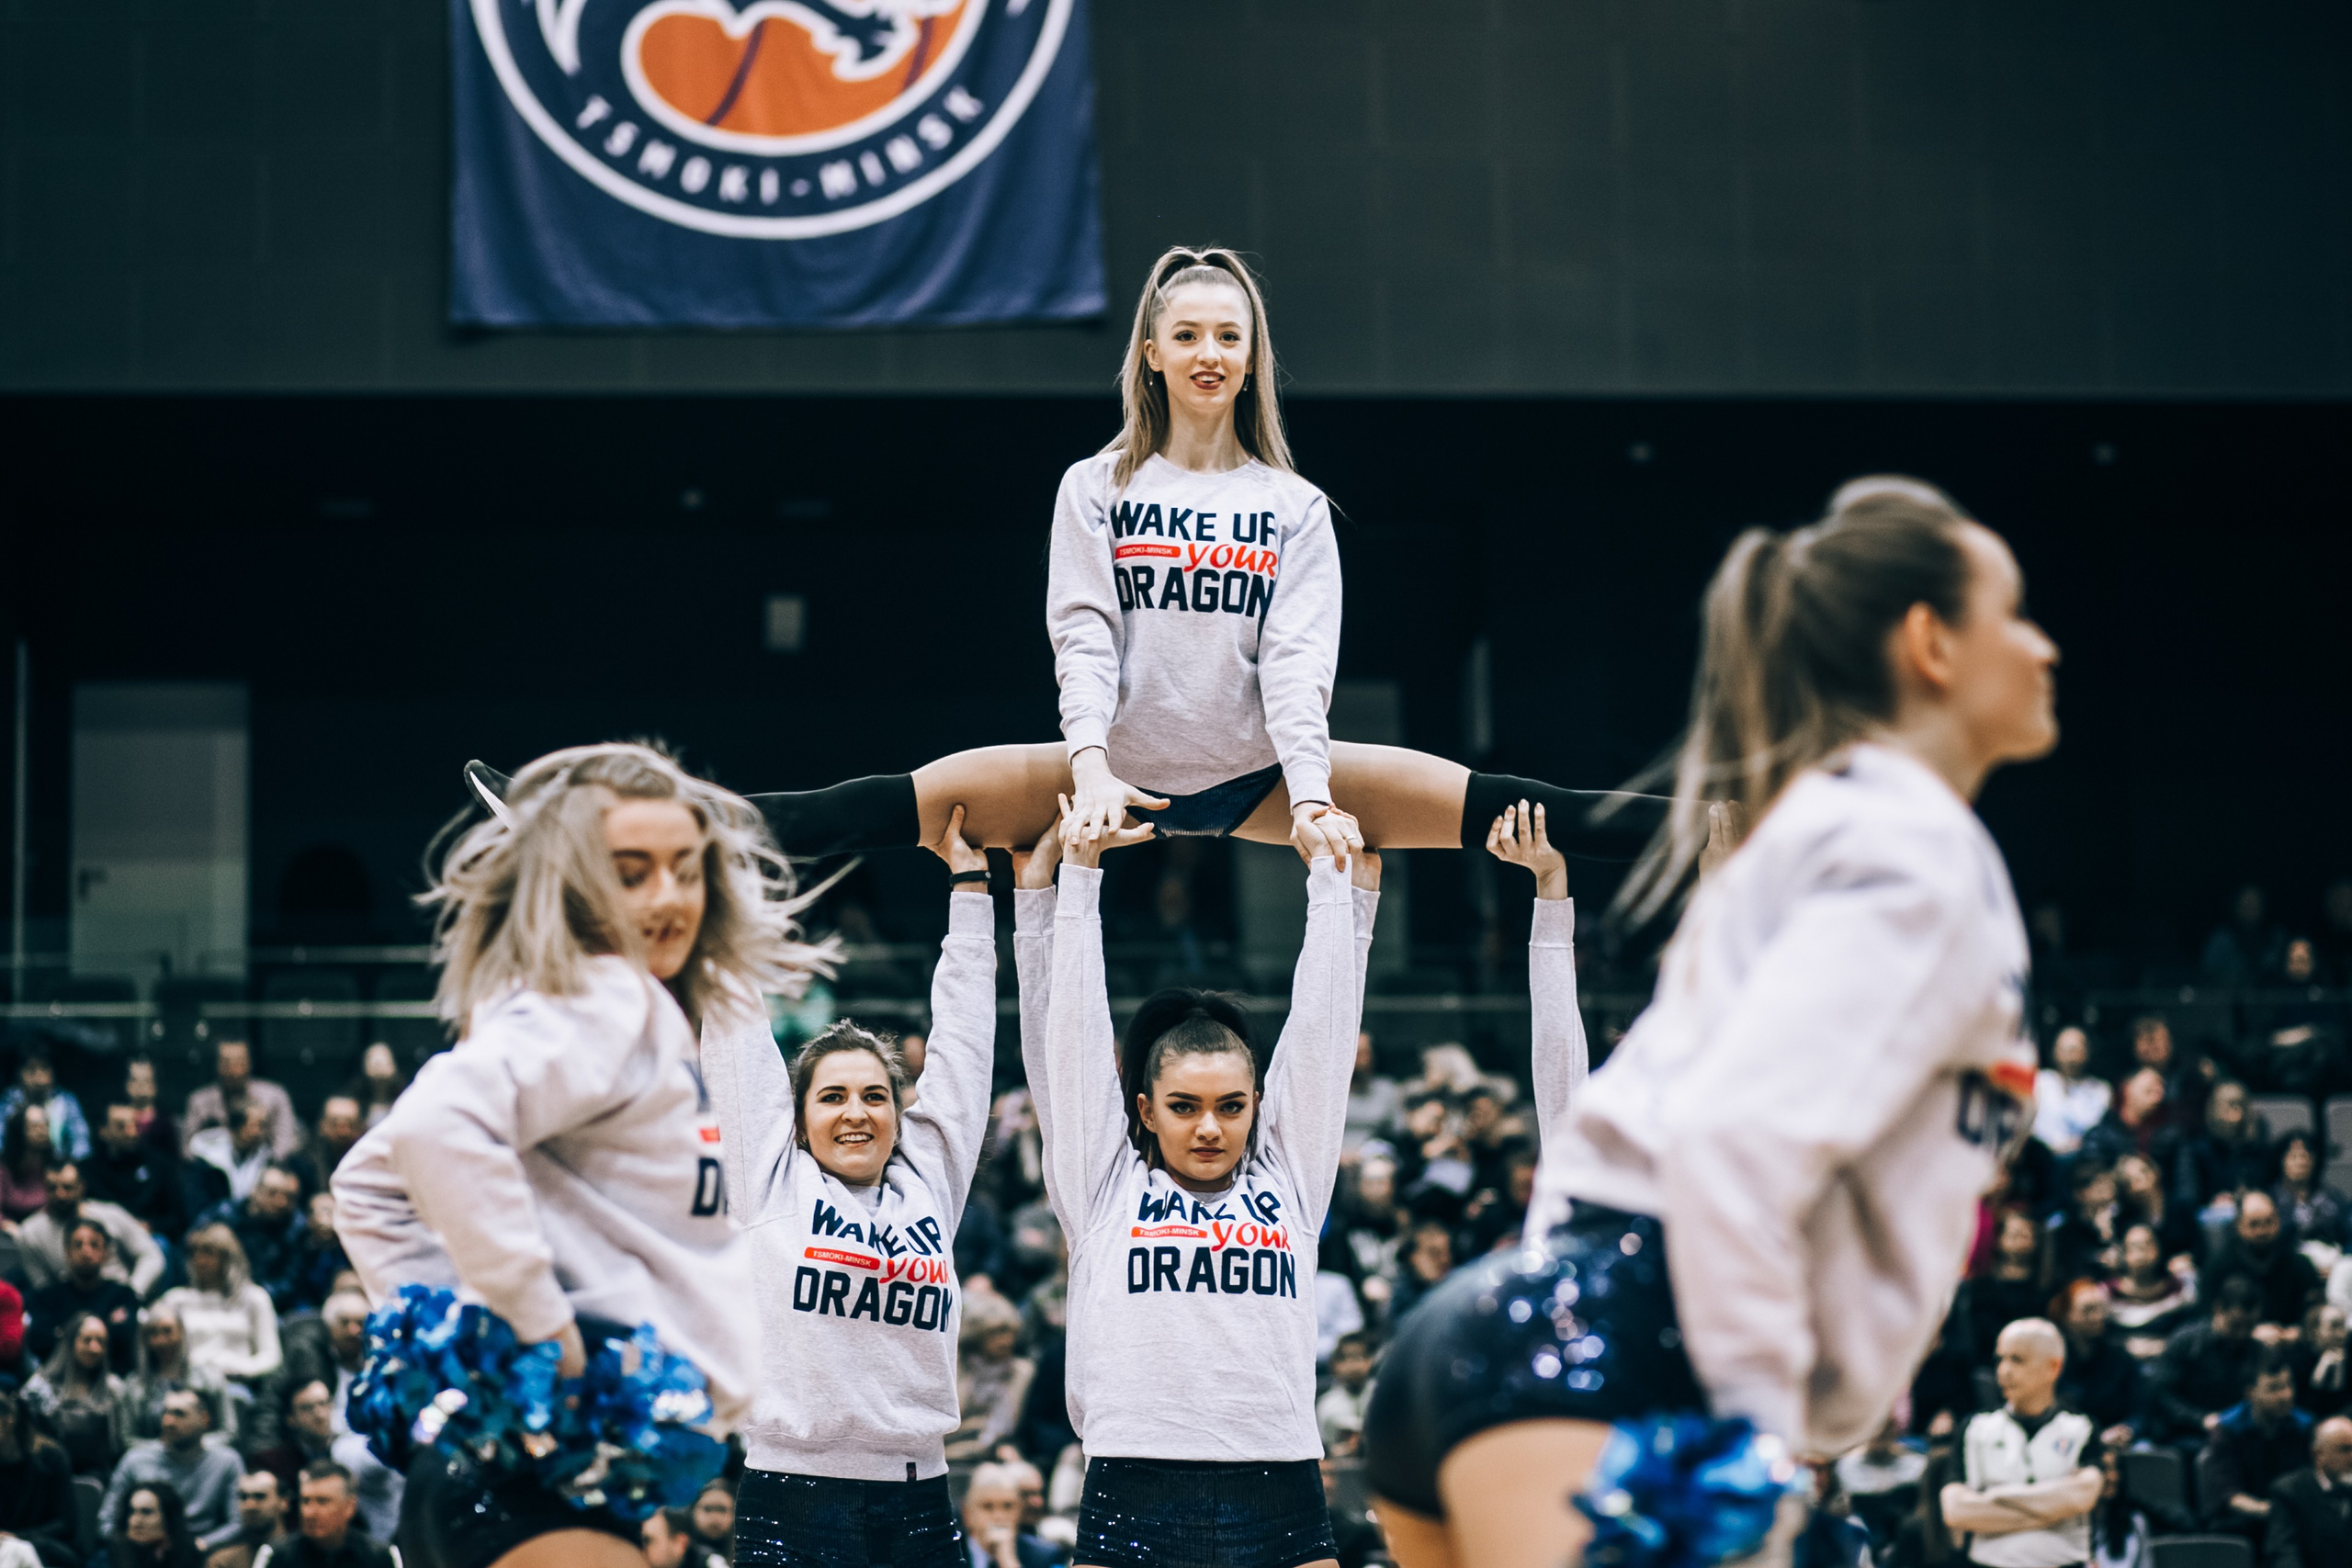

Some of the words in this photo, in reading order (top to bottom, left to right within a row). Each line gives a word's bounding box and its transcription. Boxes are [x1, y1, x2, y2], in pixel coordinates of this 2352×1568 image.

[578, 85, 984, 205] TSMOKI-MINSK
[1110, 500, 1217, 542] WAKE
[1232, 511, 1276, 547] UP
[1119, 546, 1173, 557] TSMOKI-MINSK
[1114, 565, 1274, 620] DRAGON
[811, 1199, 908, 1259] WAKE
[905, 1215, 943, 1257] UP
[1139, 1227, 1200, 1237] TSMOKI-MINSK
[812, 1250, 872, 1267] TSMOKI-MINSK
[1128, 1246, 1296, 1299] DRAGON
[793, 1266, 953, 1332] DRAGON
